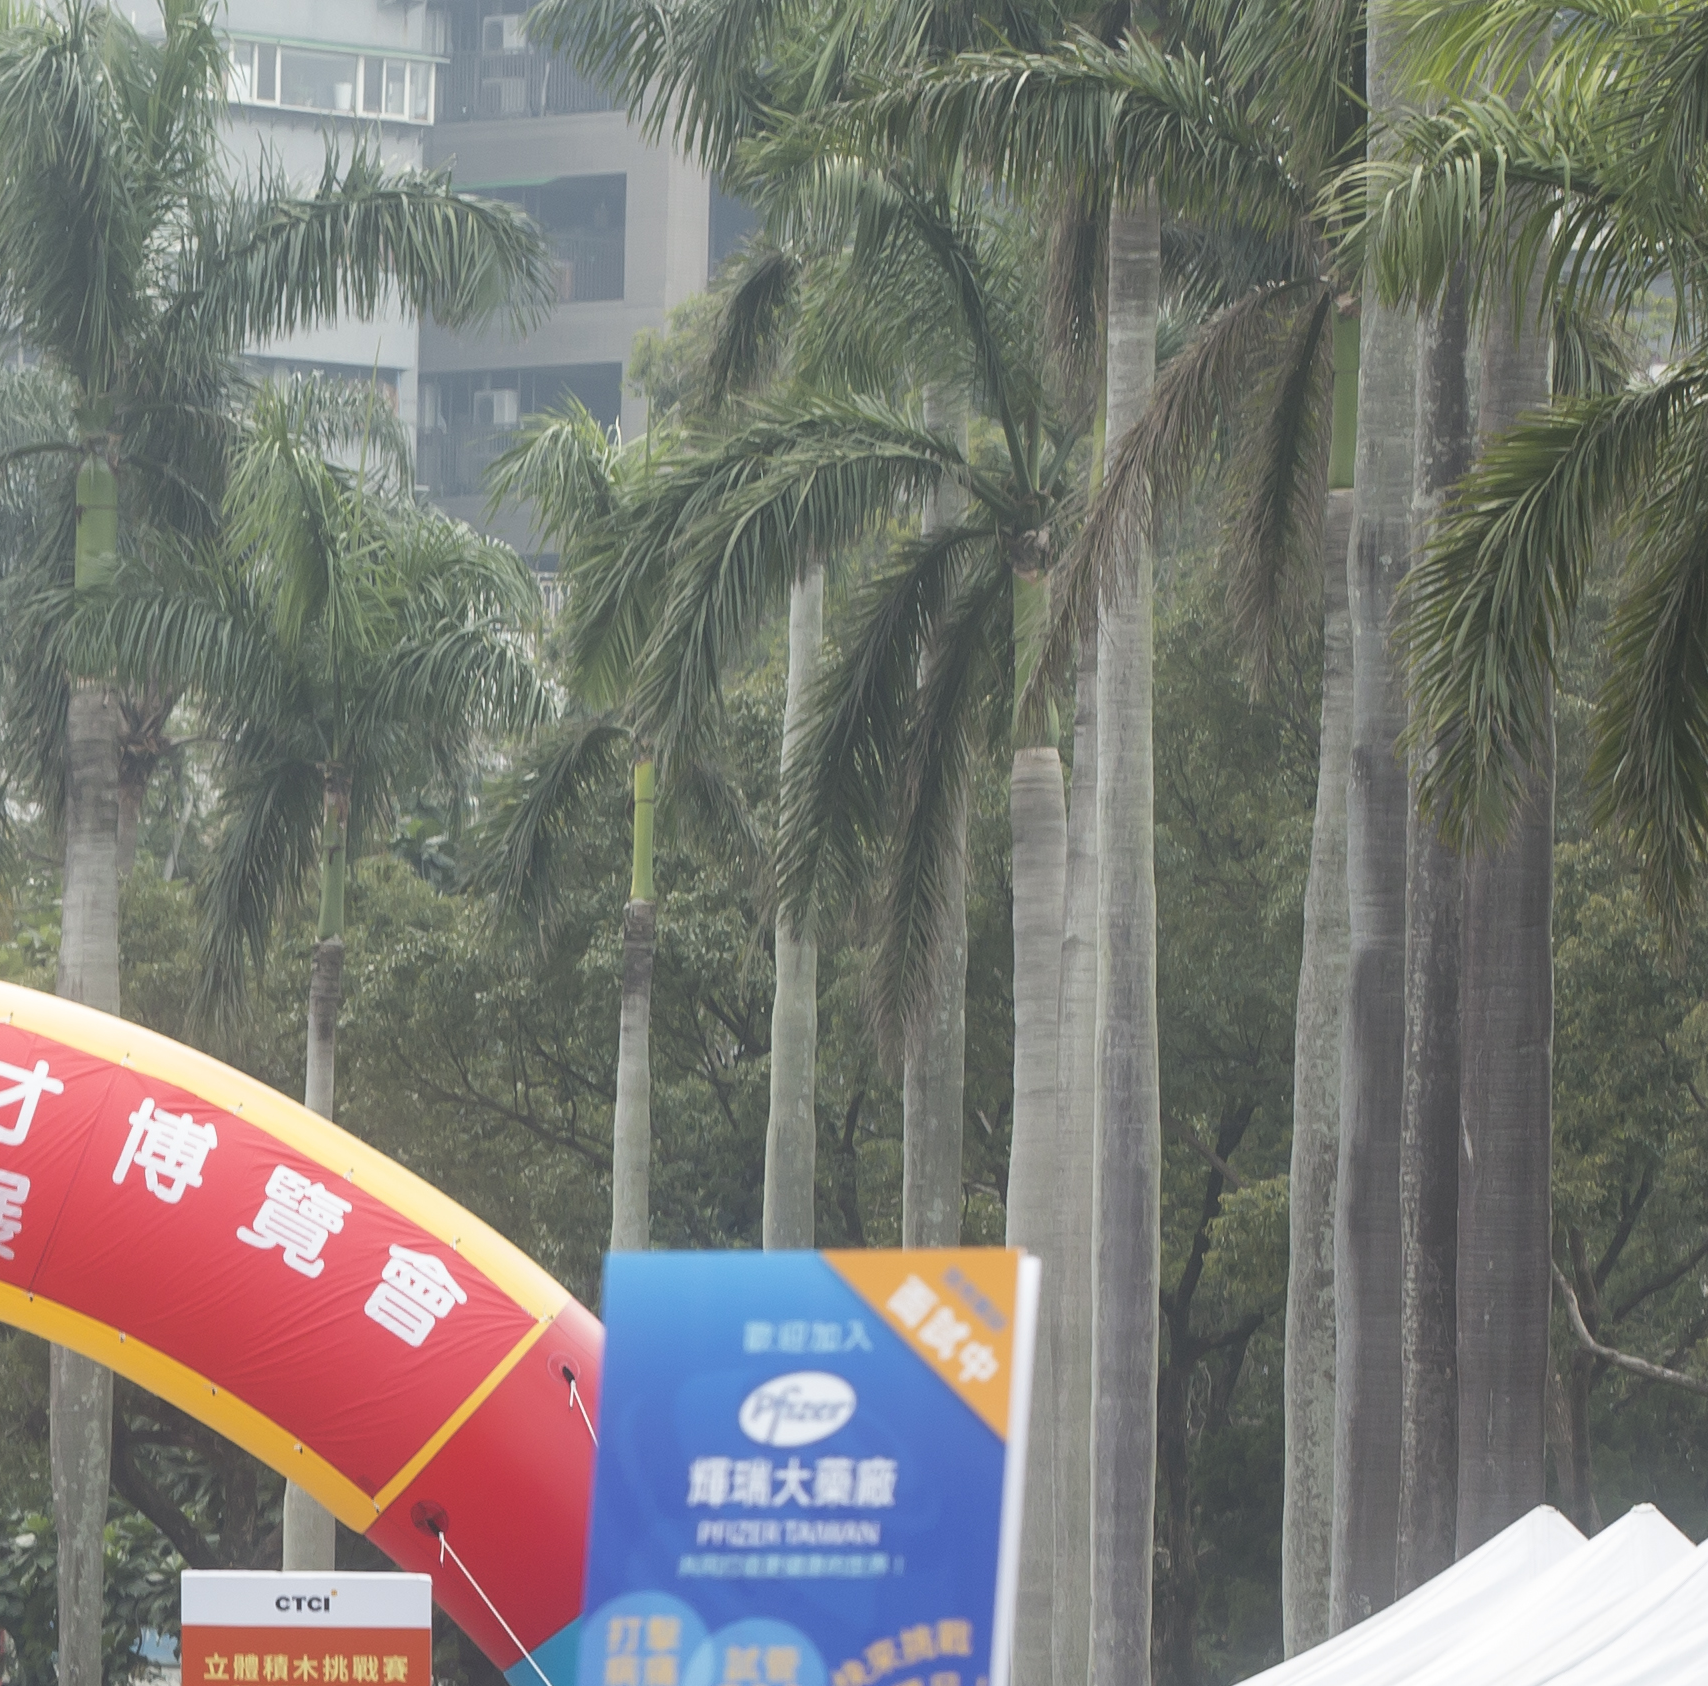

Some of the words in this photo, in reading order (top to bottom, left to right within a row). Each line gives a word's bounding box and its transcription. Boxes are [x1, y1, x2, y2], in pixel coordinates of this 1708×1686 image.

[750, 1385, 849, 1445] Pfizer
[275, 1595, 331, 1613] CTCI
[203, 1652, 409, 1684] 立體積木挑戰賽
